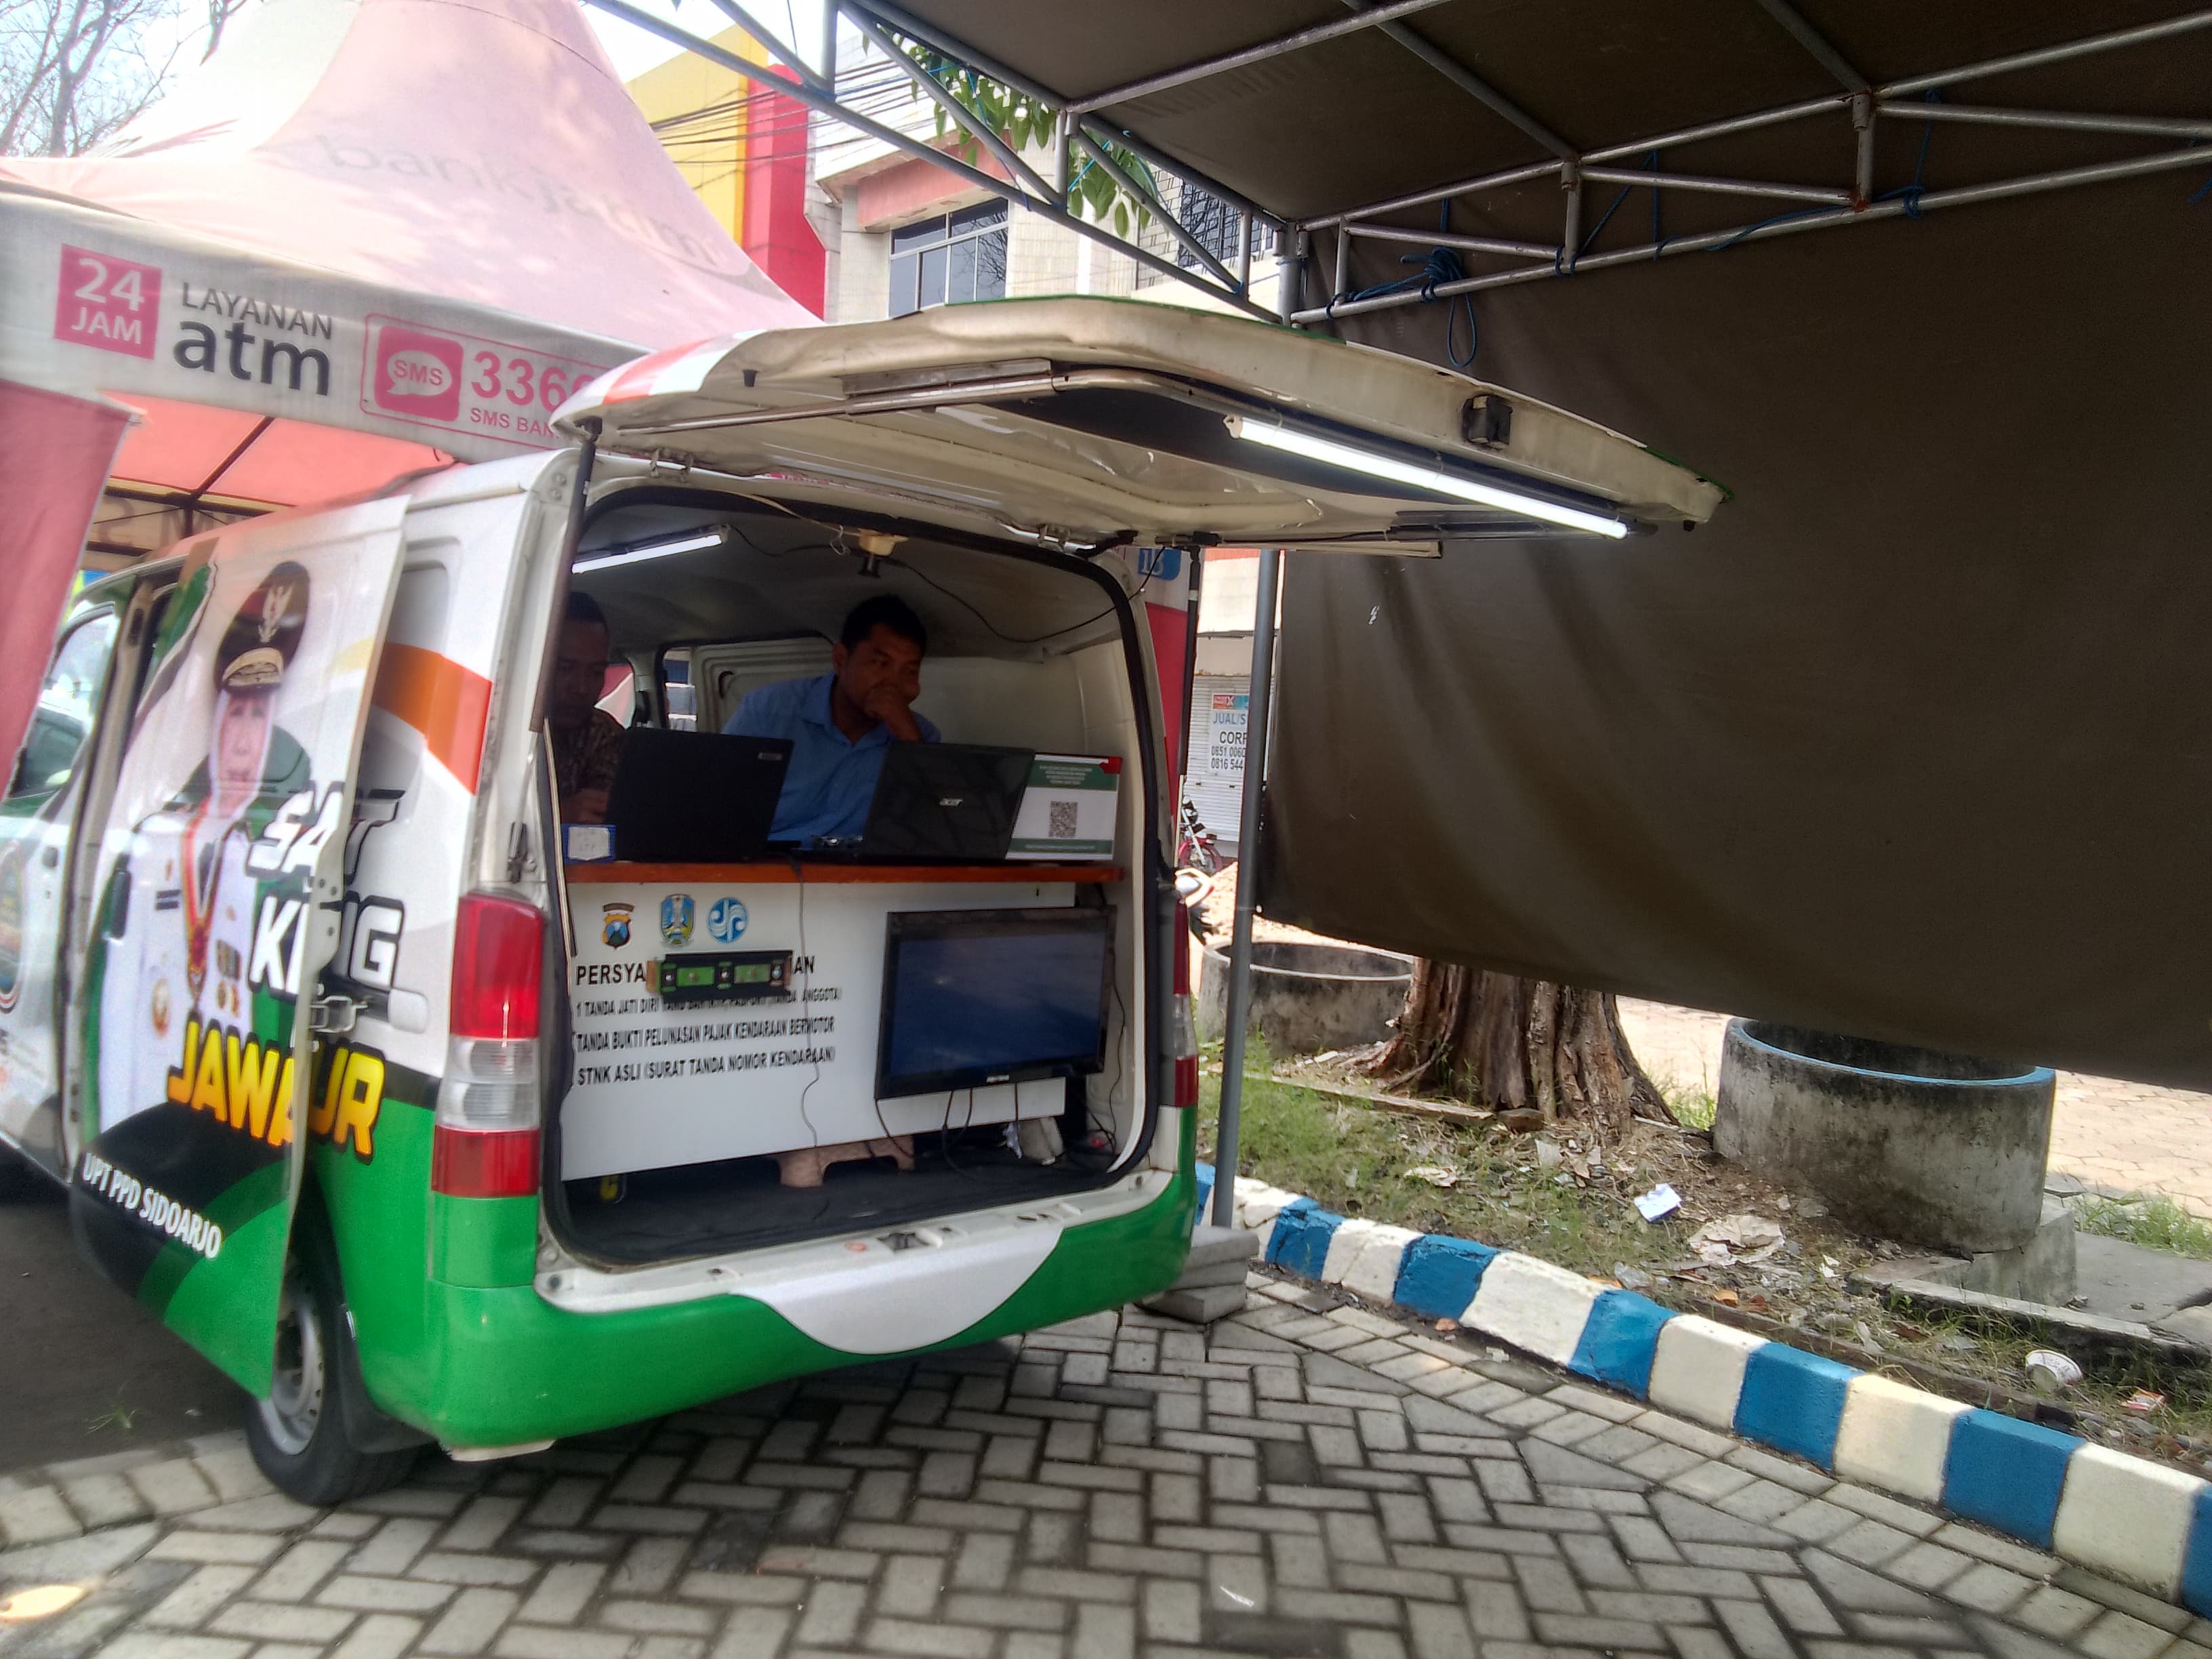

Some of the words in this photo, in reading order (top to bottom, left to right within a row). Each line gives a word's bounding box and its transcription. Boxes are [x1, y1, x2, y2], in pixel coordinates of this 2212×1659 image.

[75, 258, 145, 312] 24
[182, 282, 333, 340] LAYANAN
[71, 307, 142, 345] JAM
[173, 320, 330, 396] atm
[394, 359, 443, 386] SMS
[472, 350, 595, 413] 336
[470, 407, 510, 428] SMS
[81, 1152, 112, 1191] UPT
[108, 1169, 142, 1210] PPD
[138, 1187, 222, 1259] SIDOARJO
